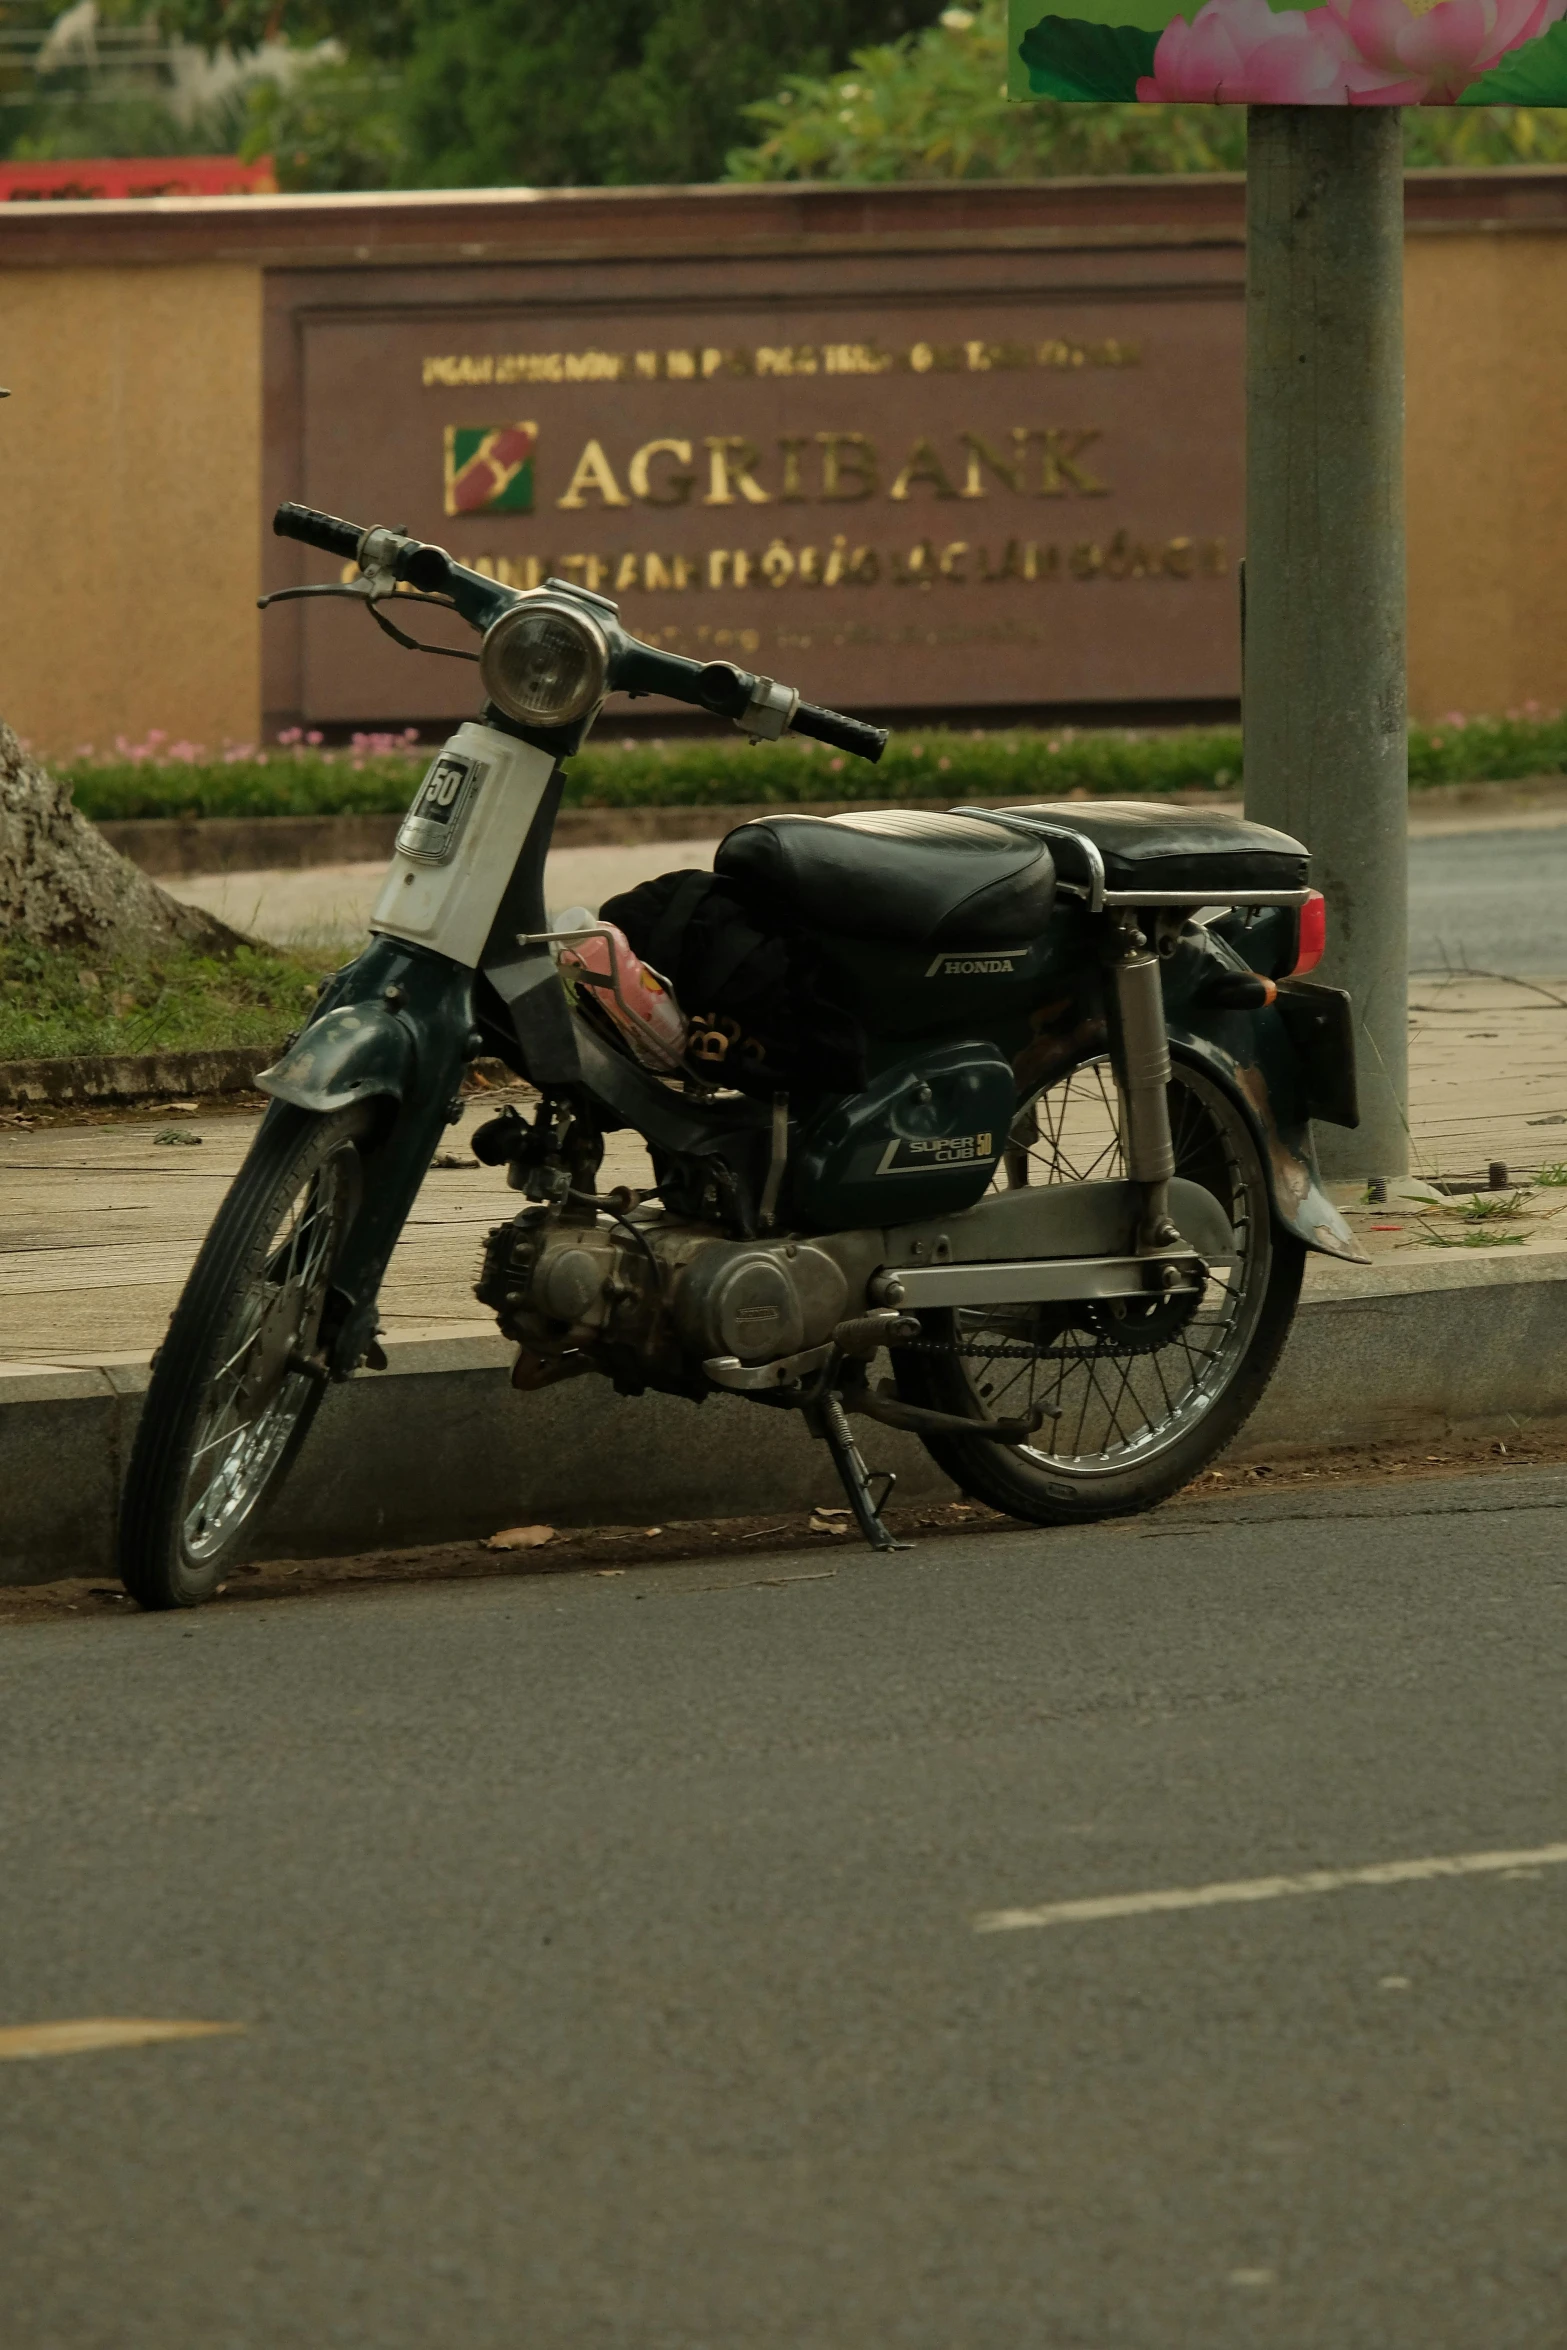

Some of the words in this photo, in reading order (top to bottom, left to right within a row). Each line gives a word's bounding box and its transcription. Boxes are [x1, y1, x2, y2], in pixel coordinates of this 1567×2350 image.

[556, 427, 1111, 510] AGRIBANK
[425, 767, 463, 807] 50
[944, 959, 1014, 975] HONDA
[909, 1137, 975, 1152] SUPER
[935, 1147, 975, 1161] CUB
[977, 1133, 992, 1156] 50
